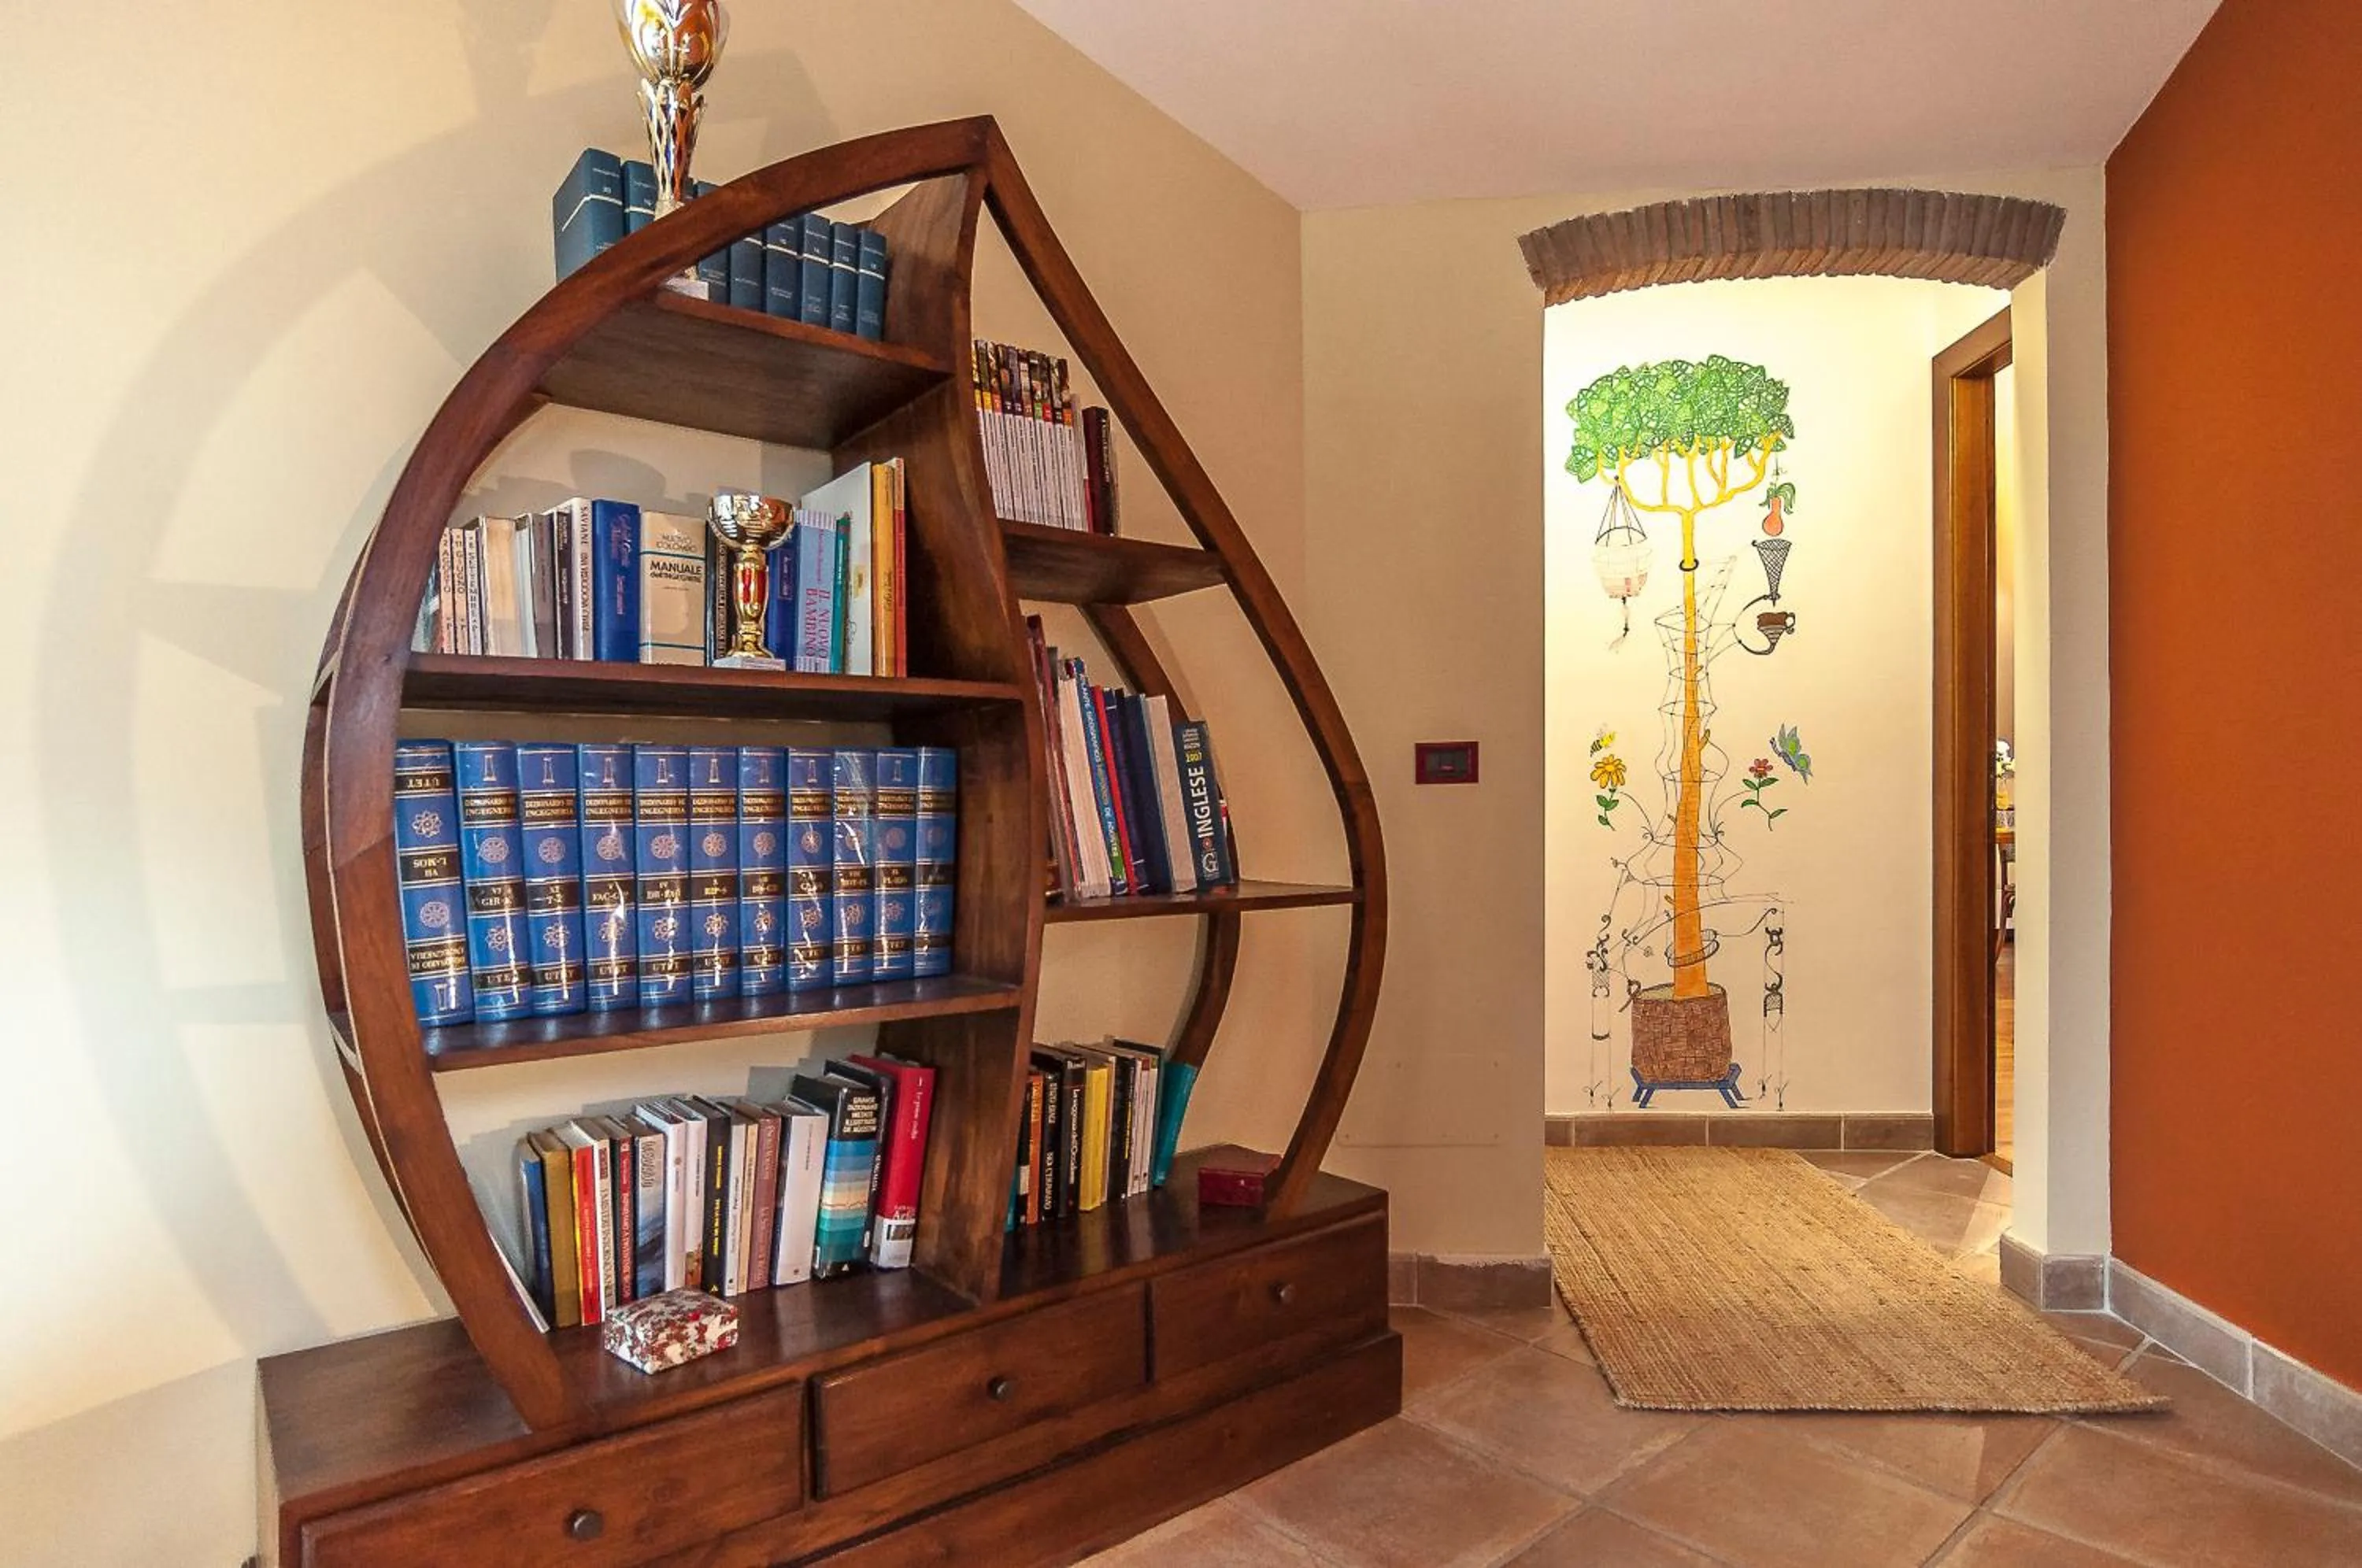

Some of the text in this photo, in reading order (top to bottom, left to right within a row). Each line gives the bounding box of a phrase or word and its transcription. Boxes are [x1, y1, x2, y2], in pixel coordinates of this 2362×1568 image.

[580, 506, 590, 545] SAVIANE
[656, 541, 697, 551] COLOMBO
[456, 551, 466, 594] GIUGNO
[650, 560, 702, 575] MANUALE
[818, 590, 831, 601] IL
[805, 588, 818, 657] BAMBINO
[818, 608, 831, 659] NUOVO
[1079, 674, 1091, 708] ATLANTE
[407, 777, 441, 789] UTET
[525, 798, 565, 808] DIZIONARIO
[585, 798, 623, 807] DIZIONARIO
[639, 798, 676, 807] DIZIONARIO
[692, 797, 727, 805] DIZIONARIO
[1188, 765, 1215, 838] INGLESE
[525, 807, 575, 817] INGEGNERIA
[585, 807, 631, 815] INGEGNERIA
[639, 807, 685, 815] INGEGNERIA
[692, 805, 735, 814] INGEGNERIA
[413, 856, 448, 868] L-MOS
[599, 963, 628, 975] UTT
[544, 969, 573, 982] UTT
